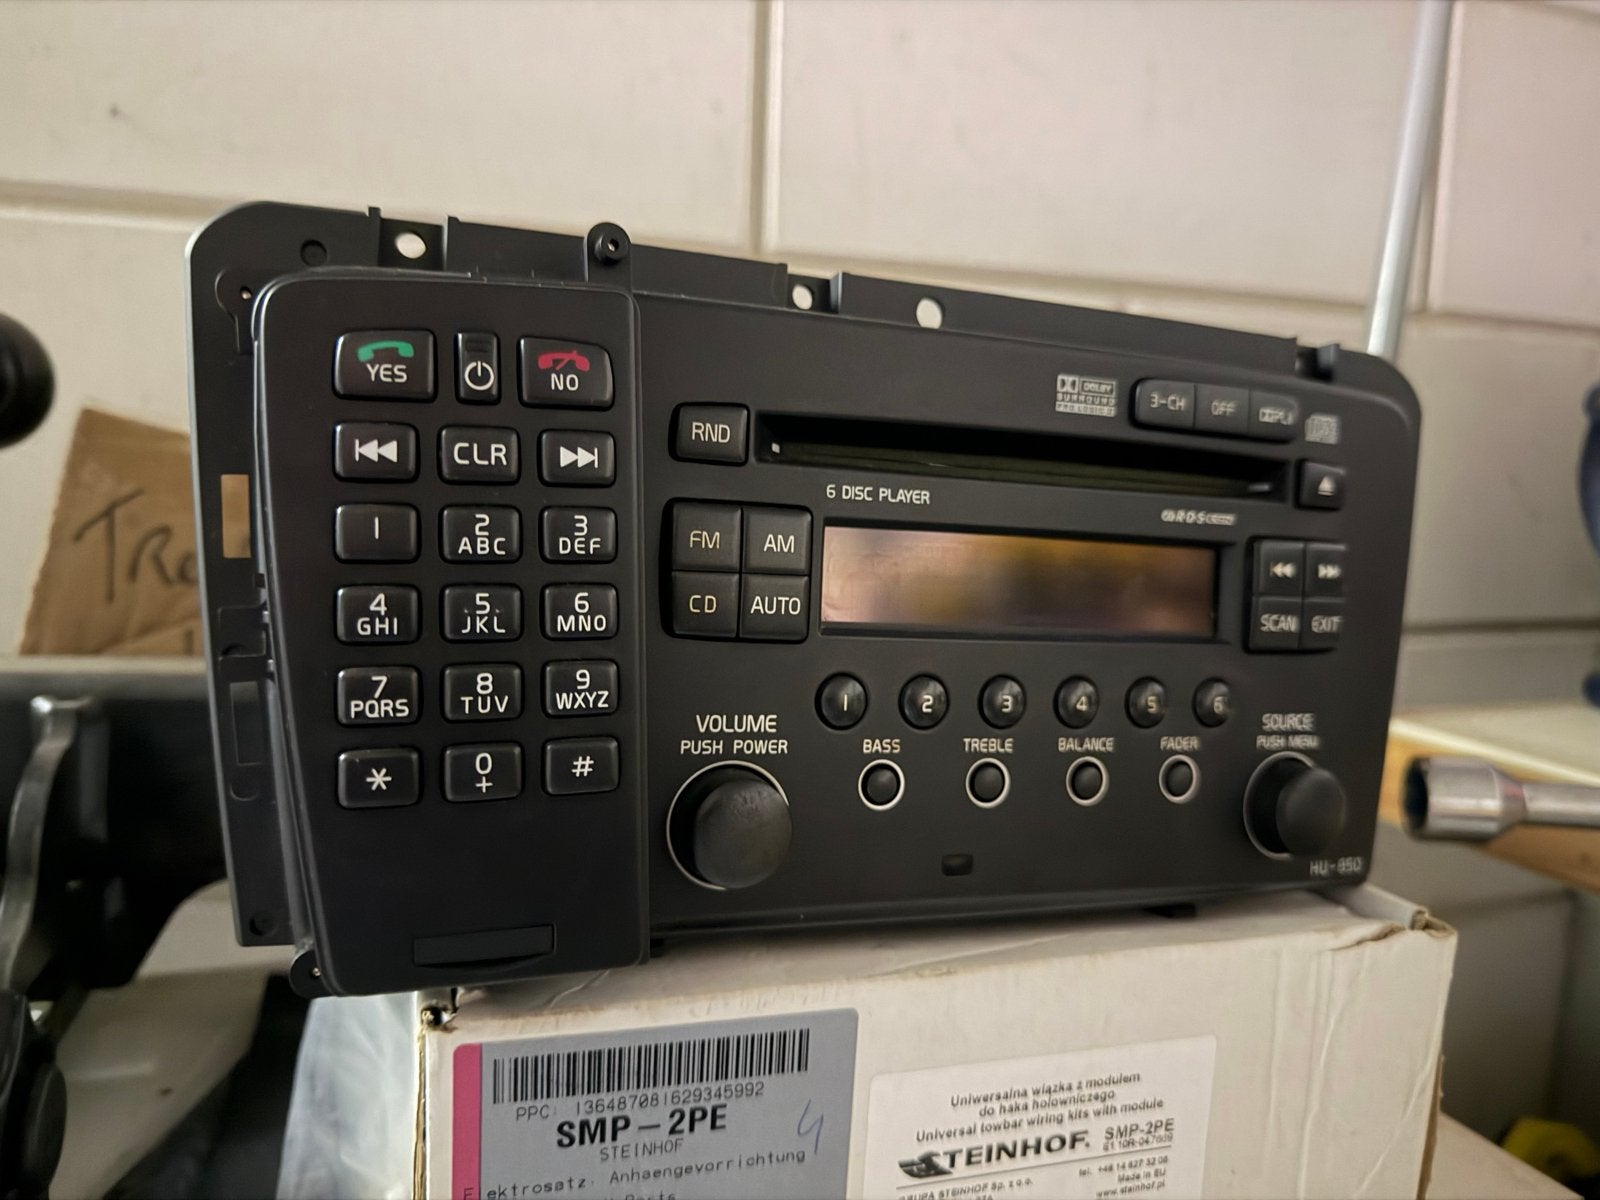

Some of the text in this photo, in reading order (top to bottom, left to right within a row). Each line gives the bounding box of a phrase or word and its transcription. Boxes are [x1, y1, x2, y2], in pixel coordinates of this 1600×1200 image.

[366, 363, 408, 383] YES
[550, 373, 579, 391] NO
[1150, 394, 1187, 412] 3-CH
[1211, 401, 1236, 416] OFF
[691, 421, 731, 444] RND
[453, 442, 508, 466] CLR
[826, 484, 931, 505] 6 DISC PLAYER
[474, 513, 491, 536] 2
[573, 515, 589, 536] 3
[458, 537, 506, 556] ABC
[558, 538, 602, 555] DEF
[689, 530, 721, 549] FM
[763, 534, 796, 554] AM
[369, 593, 388, 616] 4
[475, 592, 491, 615] 5
[574, 592, 590, 614] 6
[688, 594, 718, 614] CD
[750, 596, 801, 616] AUTO
[356, 617, 398, 636] GHI
[461, 615, 506, 634] JKL
[556, 614, 607, 633] MNO
[1260, 613, 1299, 633] SCAN
[1311, 614, 1343, 634] EXIT
[371, 675, 388, 699] 7
[476, 672, 493, 695] 8
[576, 669, 591, 690] 9
[350, 698, 410, 719] PQRS
[460, 694, 509, 715] TUV
[556, 690, 609, 710] WXYZ
[922, 694, 933, 713] 2
[1001, 694, 1013, 713] 3
[1076, 695, 1088, 712] 4
[1147, 695, 1158, 713] 5
[1213, 695, 1225, 713] 6
[695, 714, 778, 734] VOLUME
[1262, 713, 1314, 732] SOURCE
[680, 738, 789, 755] PUSH POWER
[862, 738, 901, 754] BASS
[963, 737, 1014, 754] TREBLE
[1058, 736, 1115, 753] BALANCE
[1160, 735, 1200, 751] FADER
[1256, 734, 1320, 751] PUSH MENU
[475, 752, 493, 775] 0
[571, 755, 595, 778] #
[950, 1088, 1028, 1108] Uniwersalna
[1086, 1072, 1141, 1091] modulem
[979, 1091, 1116, 1117] do haka holowniczego
[916, 1126, 977, 1143] Universal
[1026, 1114, 1064, 1130] wiring
[1067, 1109, 1090, 1122] kits
[1093, 1106, 1118, 1118] with
[1120, 1099, 1165, 1114] module
[1104, 1118, 1175, 1141] SMP-2PE
[600, 1137, 684, 1162] STEINHOF
[609, 1149, 806, 1185] Anhaengevorrichtung
[1117, 1173, 1141, 1183] Made
[938, 1182, 989, 1200] STEINHOF
